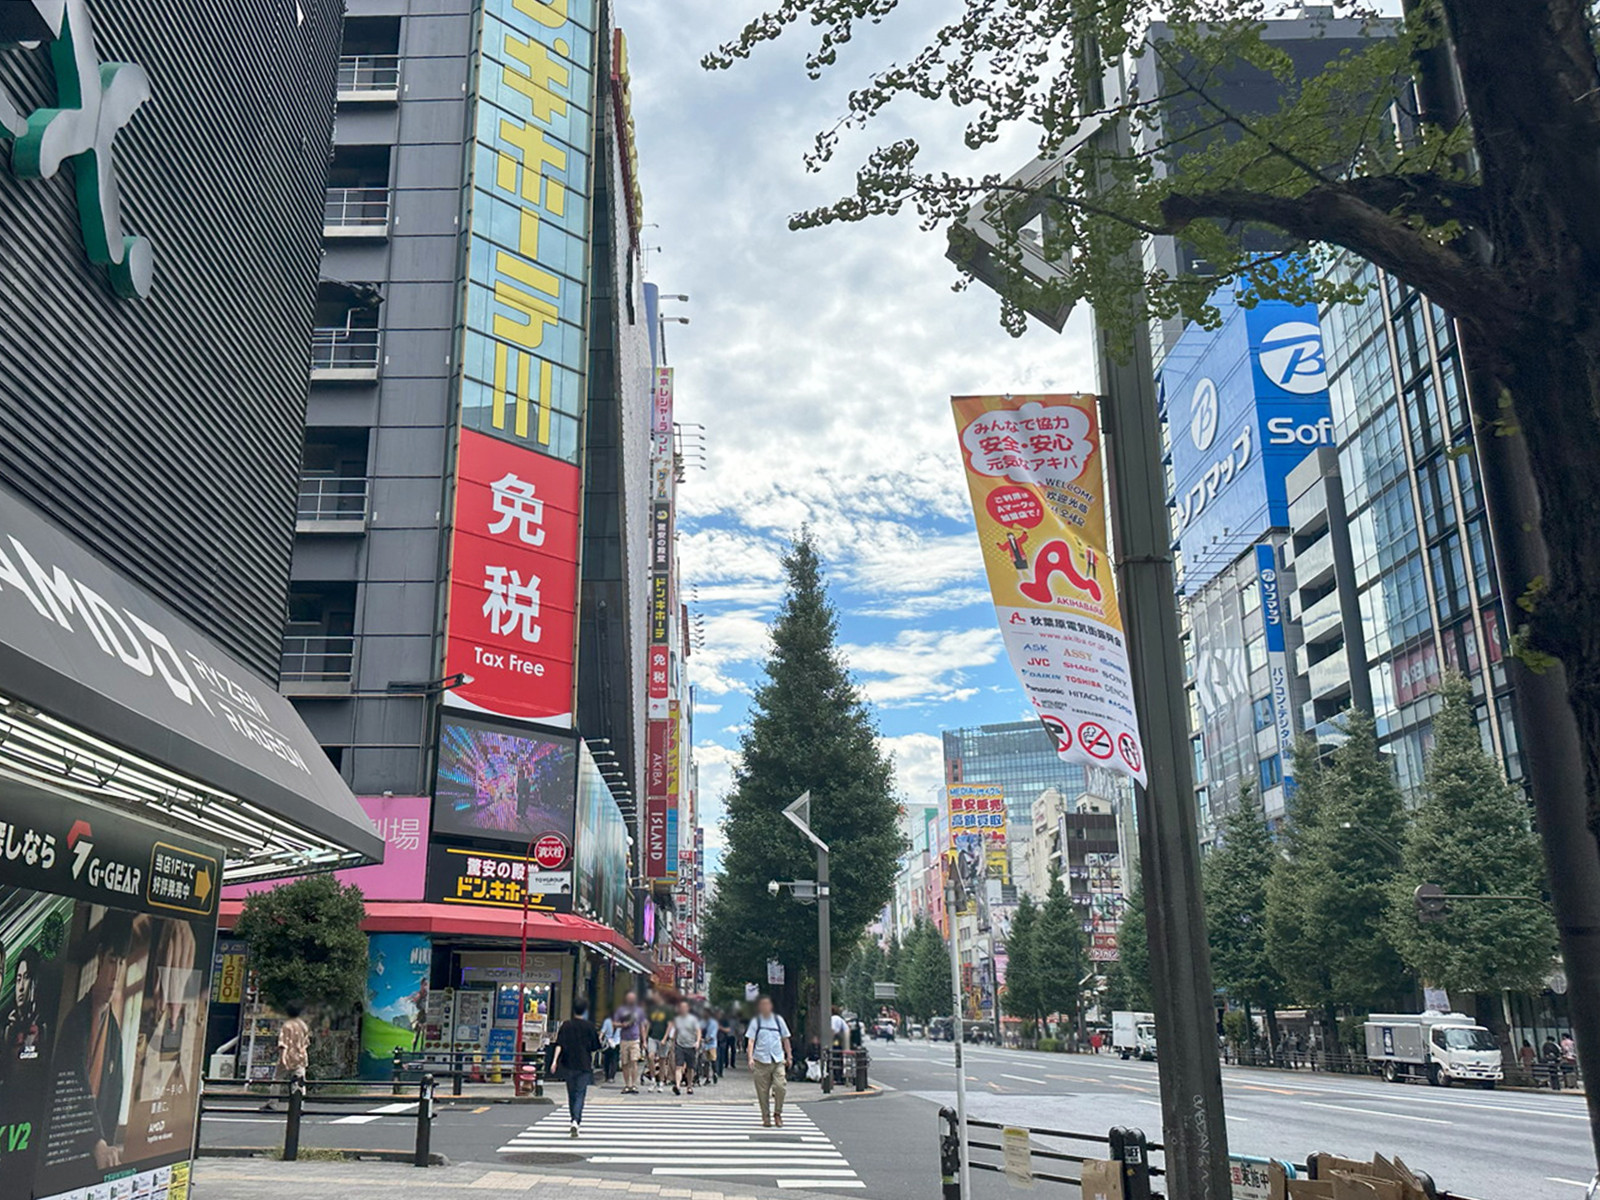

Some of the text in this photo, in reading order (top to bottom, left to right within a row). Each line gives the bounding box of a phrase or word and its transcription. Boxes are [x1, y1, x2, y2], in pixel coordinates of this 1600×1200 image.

[974, 416, 1070, 435] みんなで協力
[1268, 417, 1335, 444] Sof
[979, 433, 1074, 455] 安全・安心
[987, 455, 1078, 471] 元気なアキバ
[1176, 425, 1252, 528] ソフマップ
[1045, 478, 1094, 502] WELCOME
[482, 472, 545, 642] 免税
[1056, 597, 1105, 616] AKIHABARA
[1263, 583, 1280, 625] ソフマップ
[1024, 643, 1049, 652] ASK
[474, 646, 545, 677] Tax Free
[653, 653, 666, 684] 免税
[1027, 657, 1050, 667] JVC
[1063, 661, 1099, 674] SHARP
[185, 649, 271, 723] RYZEN
[1029, 672, 1061, 680] DAIKIN
[1065, 675, 1102, 688] TOSHIBA
[1069, 690, 1105, 704] HITACHI
[217, 703, 313, 776] RADEON
[653, 752, 663, 786] AKIBA
[651, 811, 663, 860] ISLAND
[537, 845, 564, 858] 消火栓
[88, 857, 141, 896] G-GEAR
[154, 853, 196, 880] 当店1Fにて
[151, 876, 191, 901] 好評発売中
[502, 955, 546, 968] IQOS
[8, 1122, 32, 1152] V2
